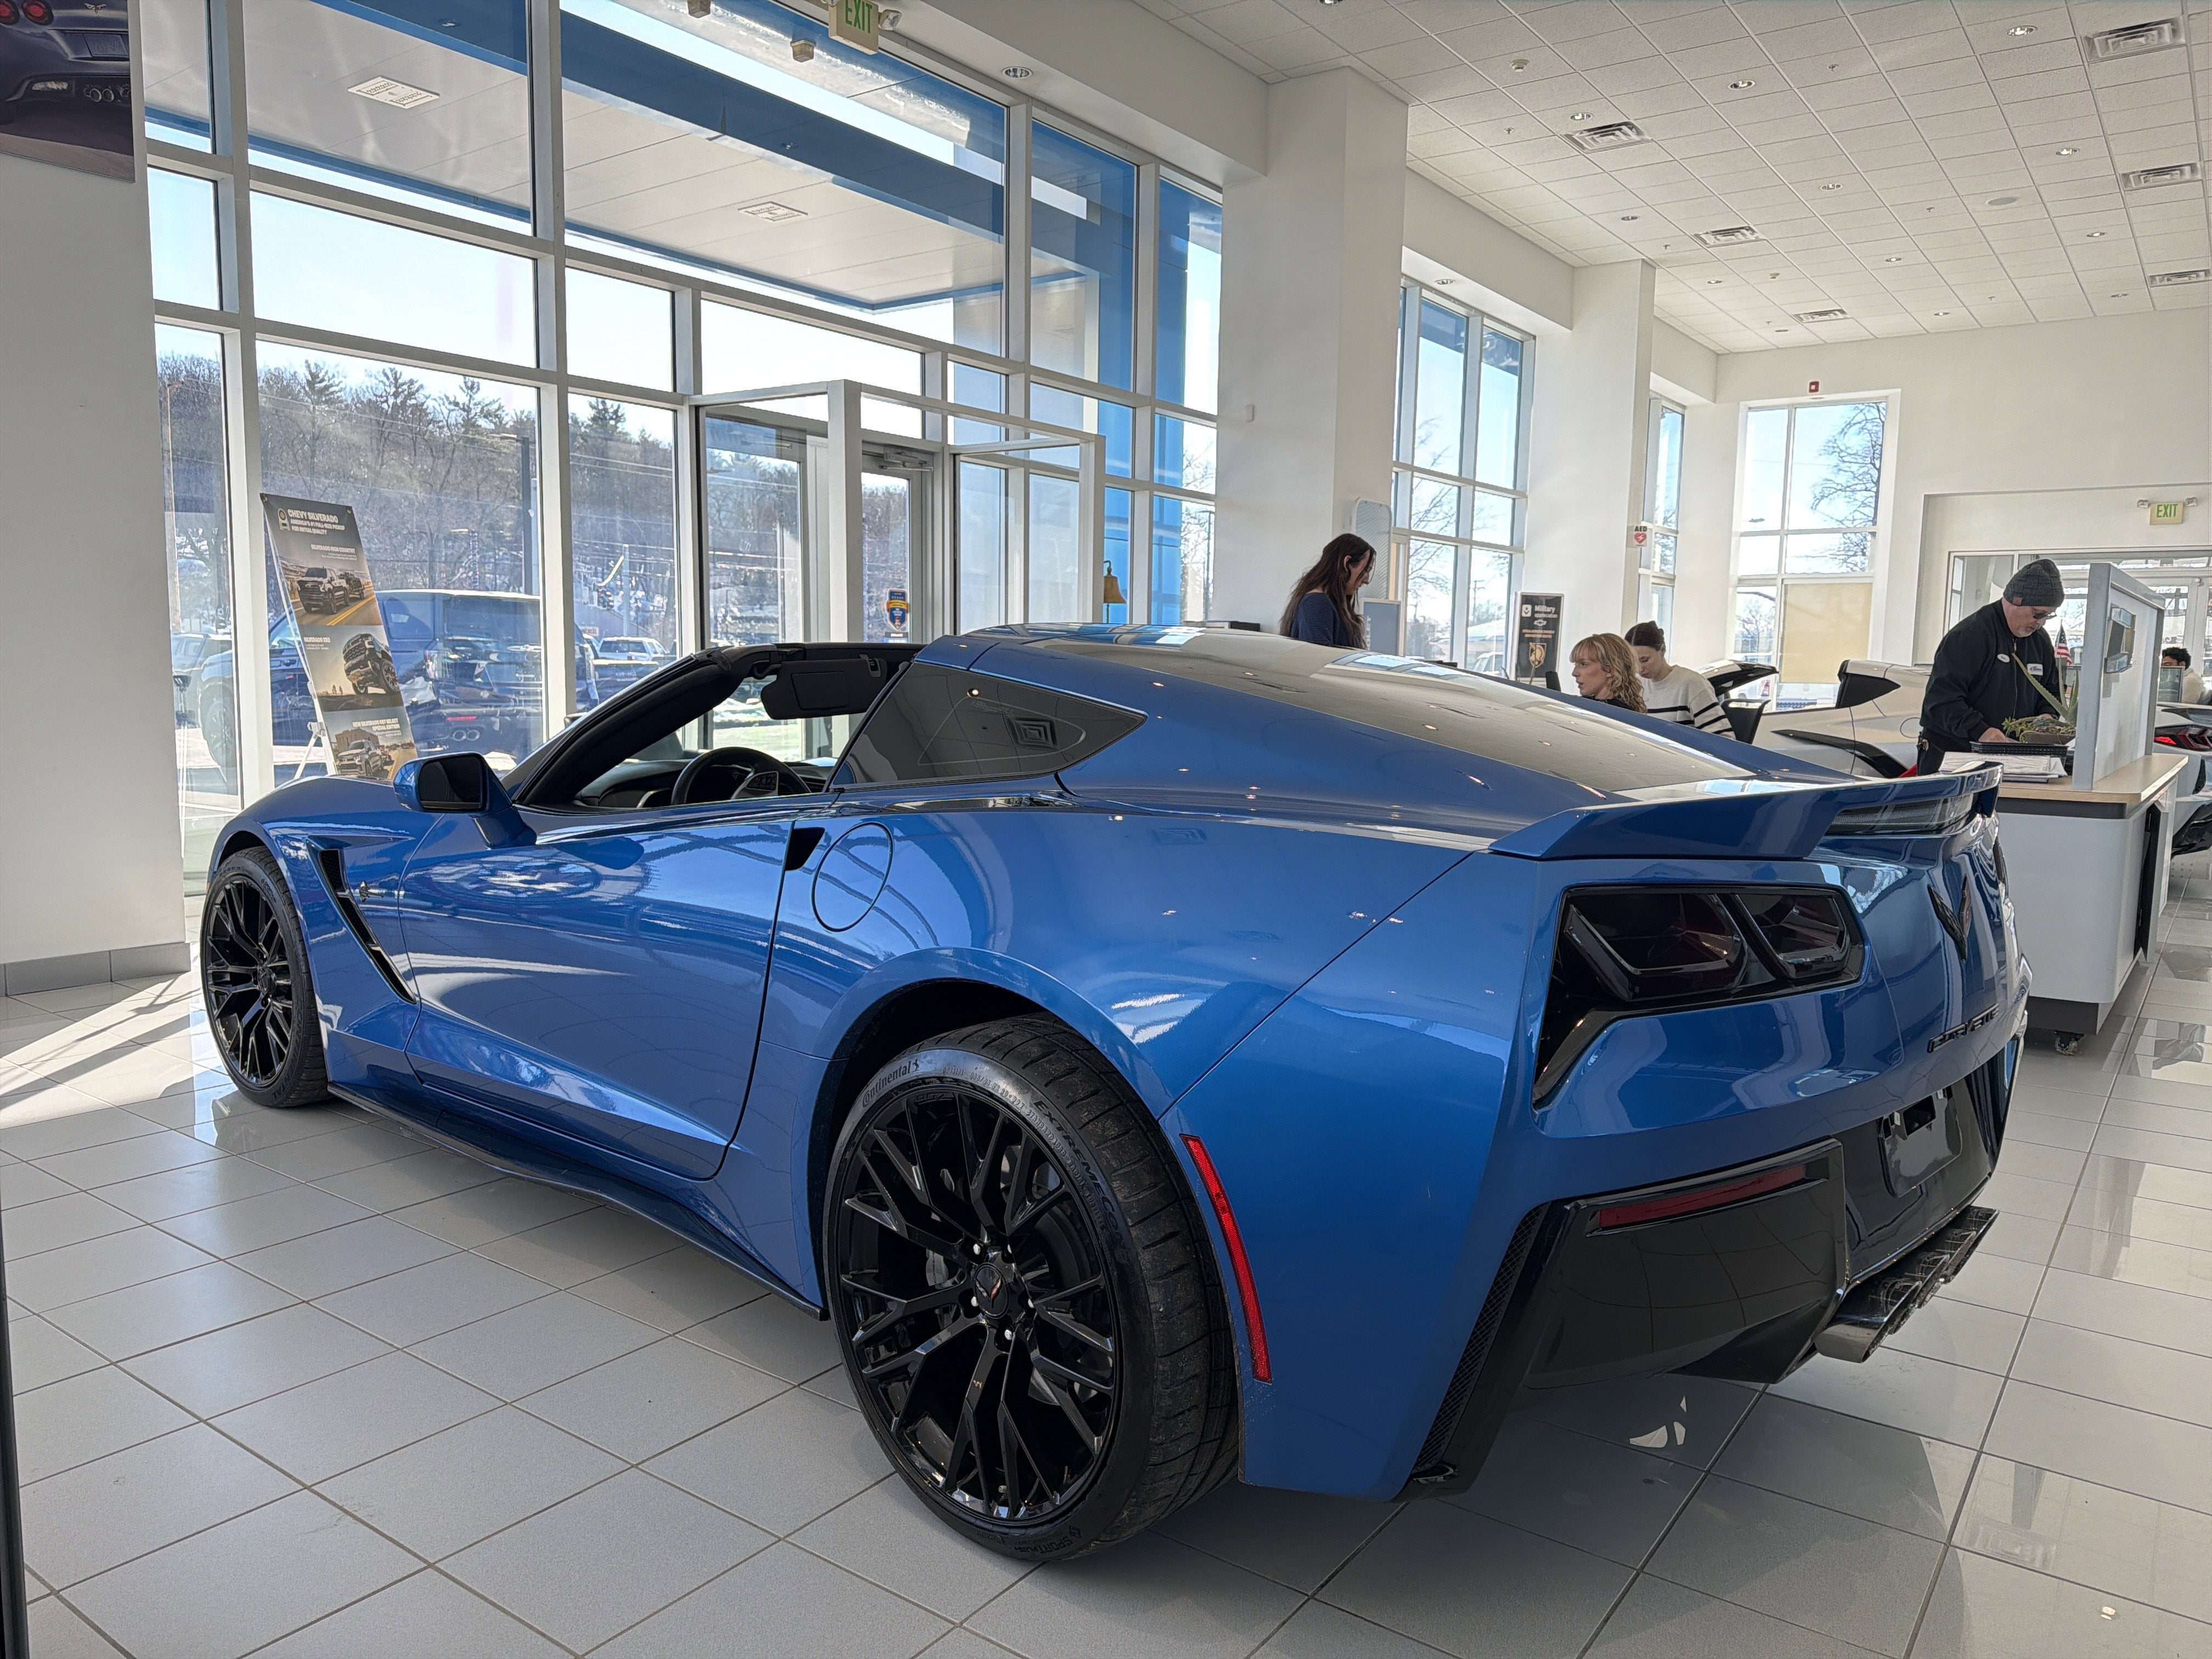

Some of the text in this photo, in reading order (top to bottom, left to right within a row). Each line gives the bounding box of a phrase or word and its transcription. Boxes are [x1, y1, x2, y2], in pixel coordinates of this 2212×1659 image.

[845, 0, 872, 33] EXIT
[287, 509, 338, 523] CHEVY SILVERADO
[2156, 504, 2178, 518] EXIT
[1534, 605, 1556, 614] Military
[862, 1060, 912, 1108] Continental
[1026, 1109, 1054, 1141] STANDARD
